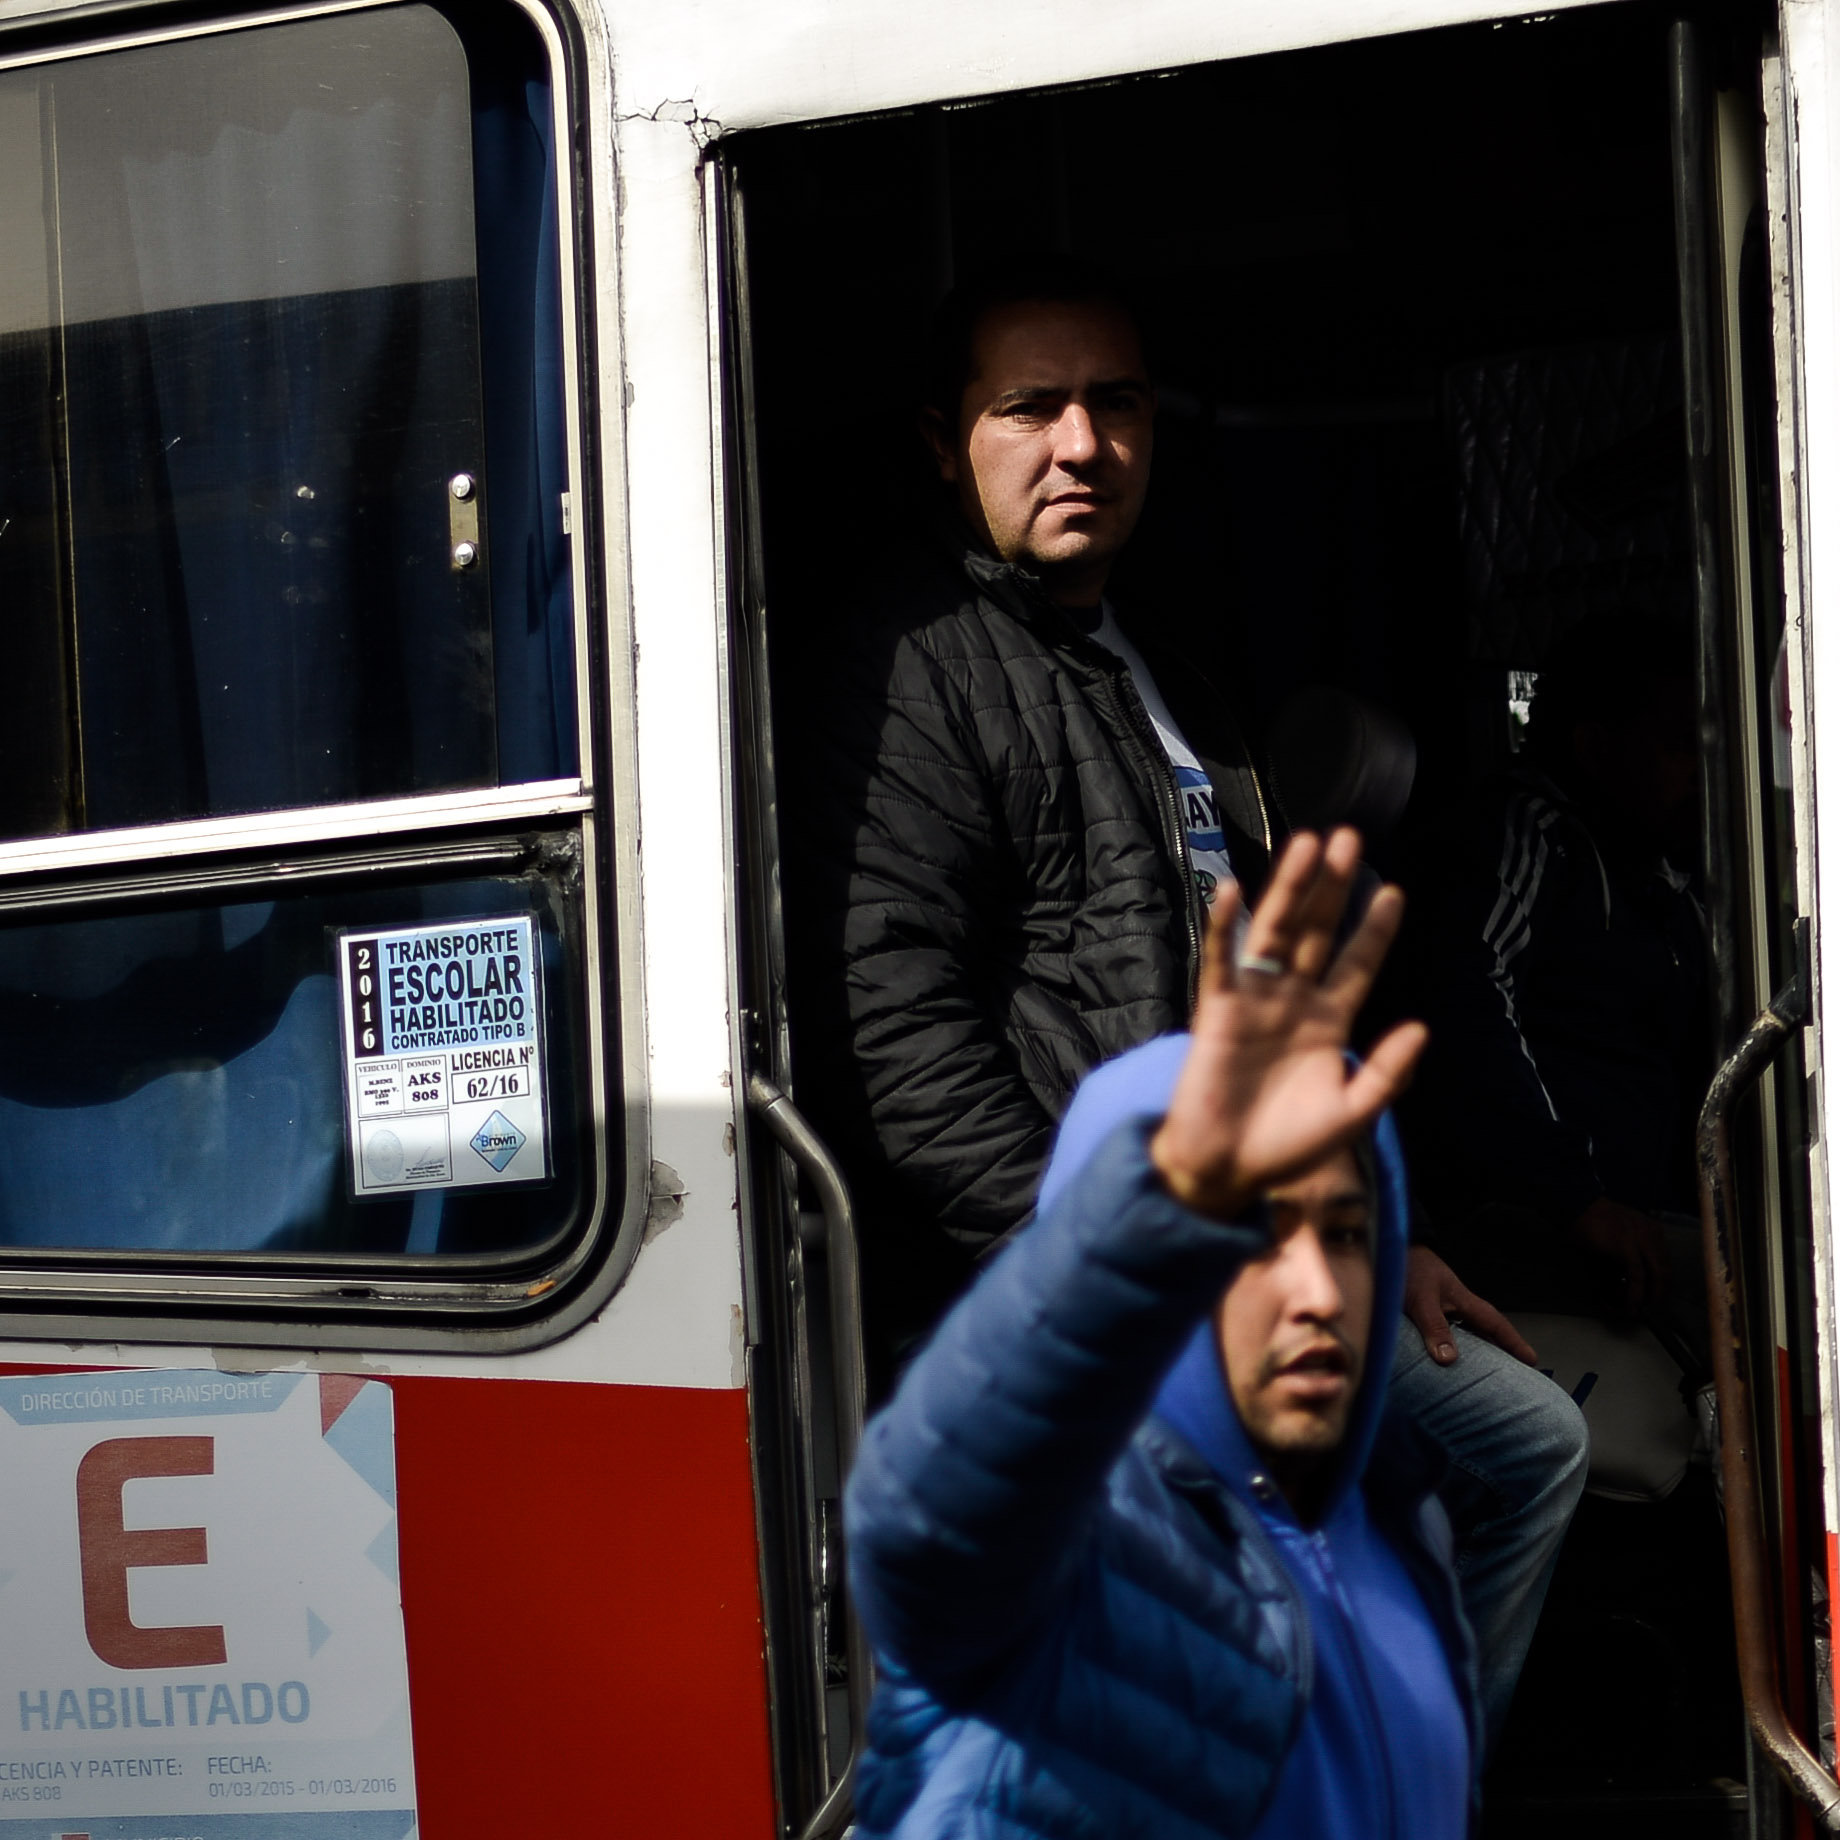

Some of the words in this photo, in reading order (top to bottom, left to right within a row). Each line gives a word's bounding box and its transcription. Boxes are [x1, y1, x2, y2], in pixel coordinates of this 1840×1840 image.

[385, 929, 519, 965] TRANSPORTE
[388, 954, 524, 1006] ESCOLAR
[358, 947, 376, 1050] 2016
[390, 995, 524, 1033] HABILITADO
[391, 1026, 479, 1050] CONTRATADO
[482, 1023, 513, 1040] TIPO
[516, 1022, 526, 1036] B
[406, 1059, 442, 1069] DOMINIO
[451, 1048, 516, 1072] LICENCIA
[408, 1072, 442, 1086] AKS
[467, 1073, 519, 1100] 62/16
[412, 1089, 439, 1102] 808
[481, 1135, 516, 1147] Brown
[21, 1386, 118, 1412] DIRECCIÓN
[121, 1388, 145, 1408] DE
[150, 1381, 273, 1405] TRANSPORTE
[76, 1436, 227, 1670] E
[19, 1681, 310, 1731] HABILITADO
[70, 1760, 83, 1778] Y
[88, 1757, 182, 1778] PATENTE:
[208, 1755, 272, 1776] FECHA:
[1, 1786, 31, 1802] AKS
[33, 1785, 61, 1801] 808
[208, 1780, 294, 1799] 01/03/2015
[308, 1776, 397, 1796] 01/03/2016
